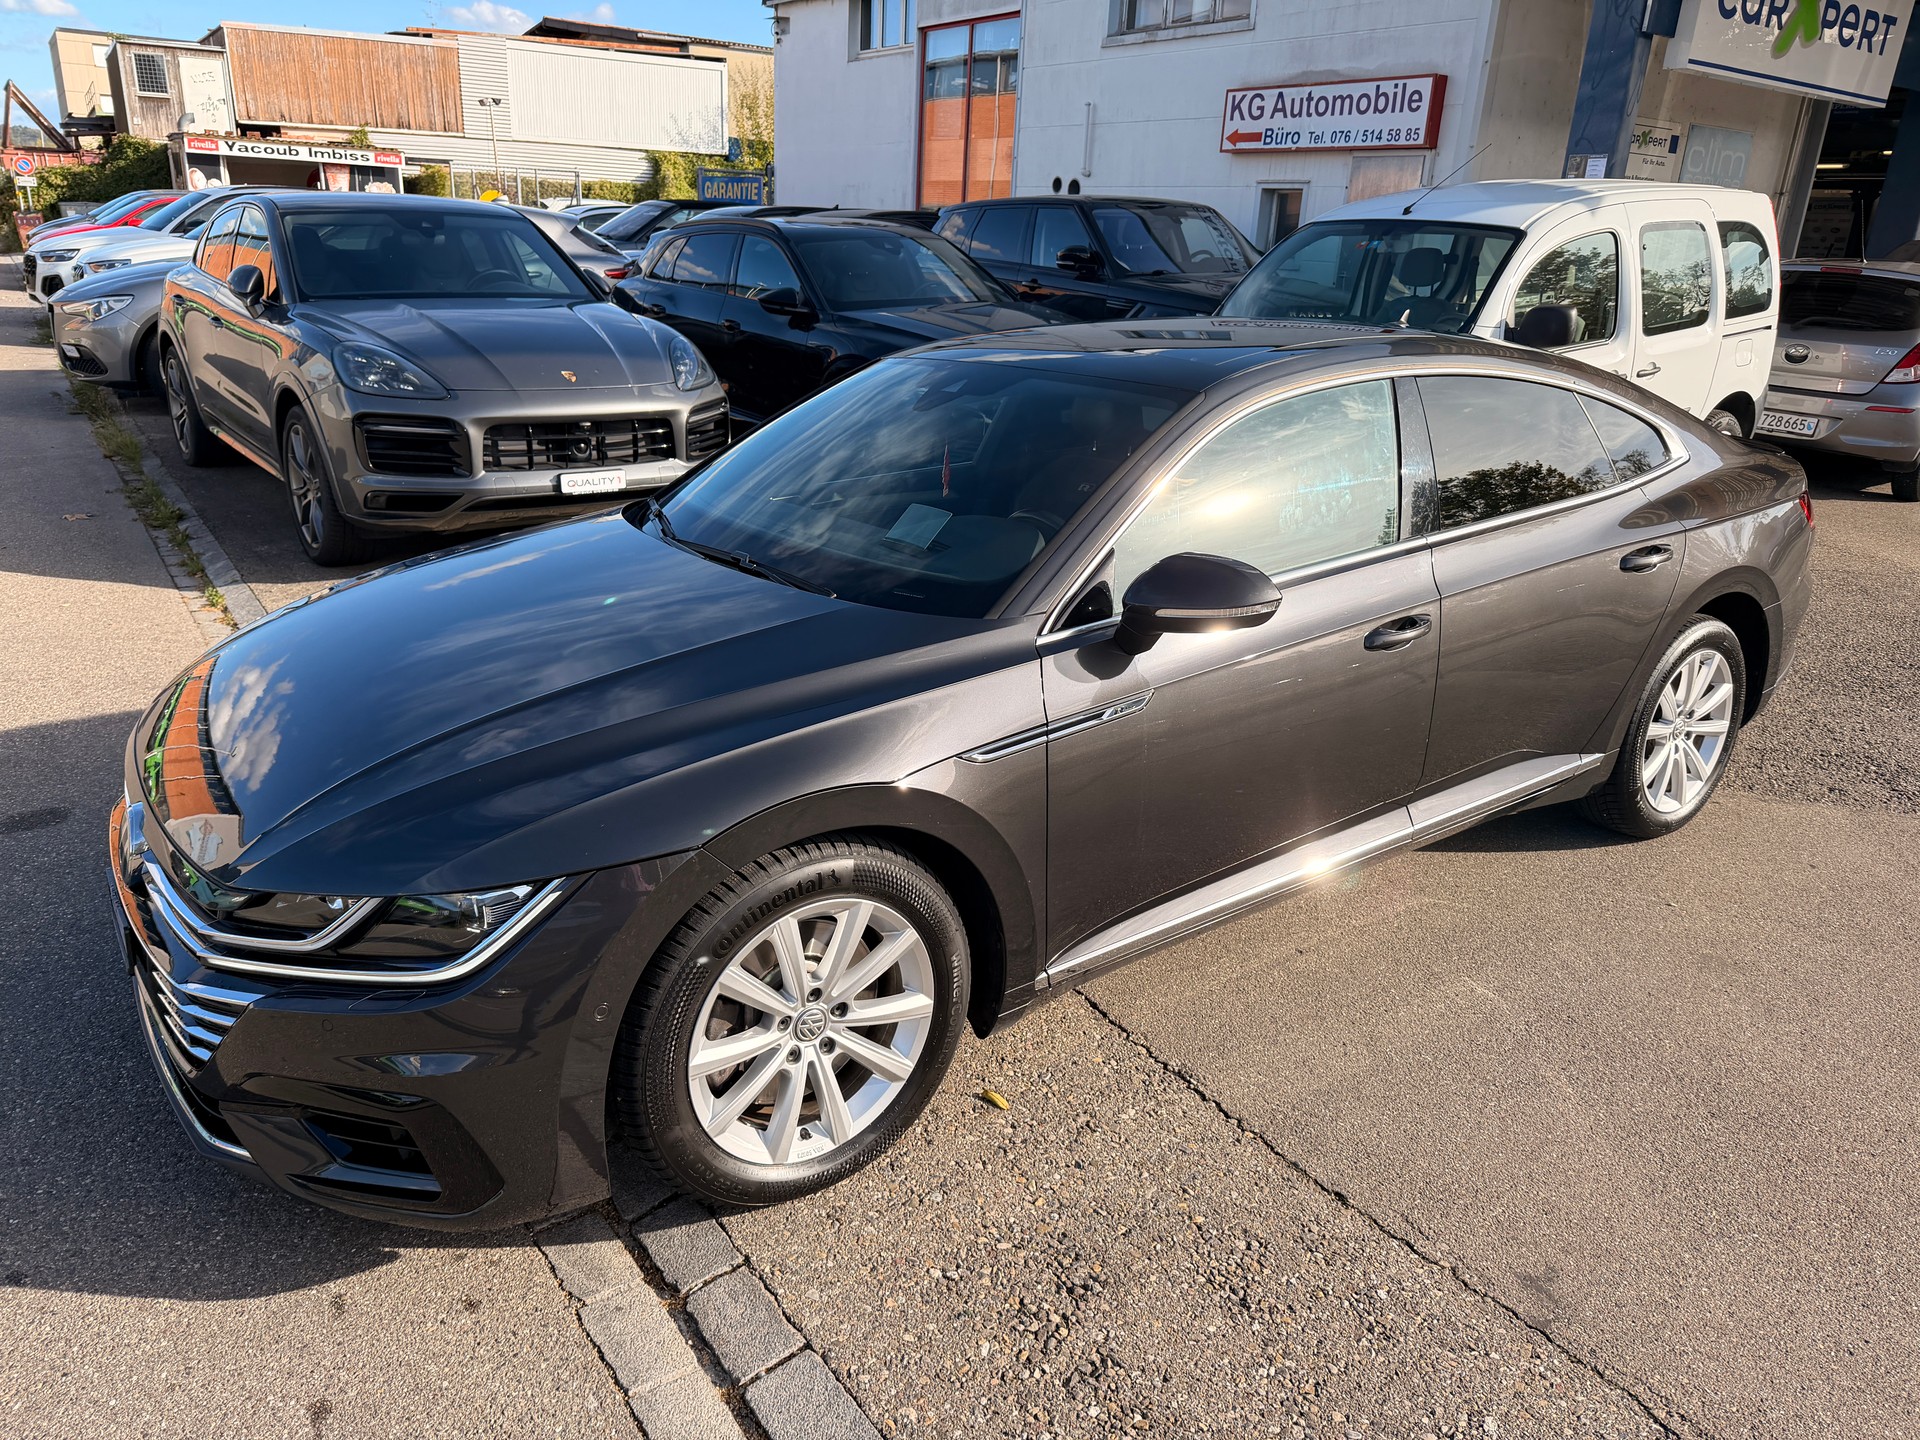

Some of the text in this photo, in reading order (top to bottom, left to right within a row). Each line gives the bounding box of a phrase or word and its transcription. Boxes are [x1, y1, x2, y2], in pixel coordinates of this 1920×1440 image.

[1229, 82, 1423, 122] KG Automobile
[190, 140, 217, 150] rivella
[1262, 127, 1420, 146] Büro Tel. 076 / 514 58 85
[224, 140, 371, 162] Yacoub Imbiss
[376, 154, 400, 163] rivella
[704, 181, 759, 200] GARANTIE
[567, 476, 615, 487] QUALITY
[711, 871, 824, 960] Continental
